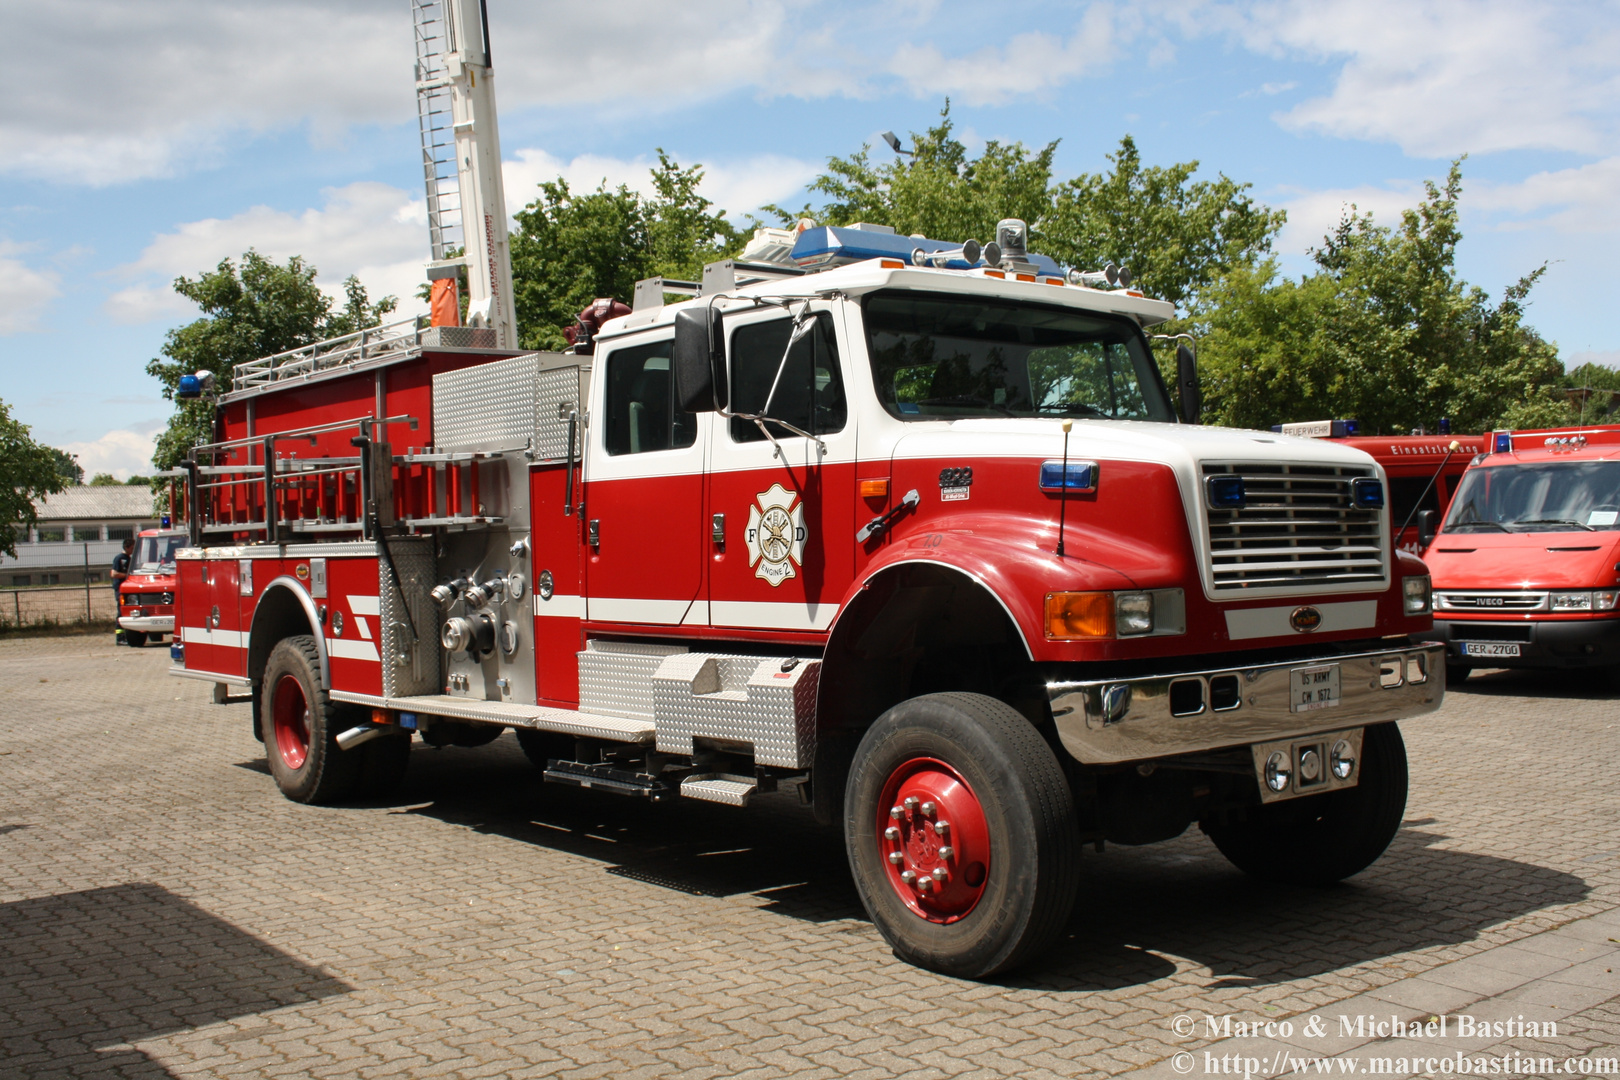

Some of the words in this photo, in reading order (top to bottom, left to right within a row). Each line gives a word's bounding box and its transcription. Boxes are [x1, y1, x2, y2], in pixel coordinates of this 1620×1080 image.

[1283, 425, 1328, 437] FEUERWEHR
[1390, 444, 1479, 455] Einsatzleung
[748, 528, 757, 543] F
[795, 526, 806, 542] D
[761, 563, 783, 576] ENGINE
[782, 562, 791, 576] 2
[1475, 597, 1504, 606] IVECO
[1467, 644, 1487, 654] GER
[1492, 645, 1518, 655] 2700
[1302, 673, 1310, 686] US
[1313, 671, 1330, 684] ARMY
